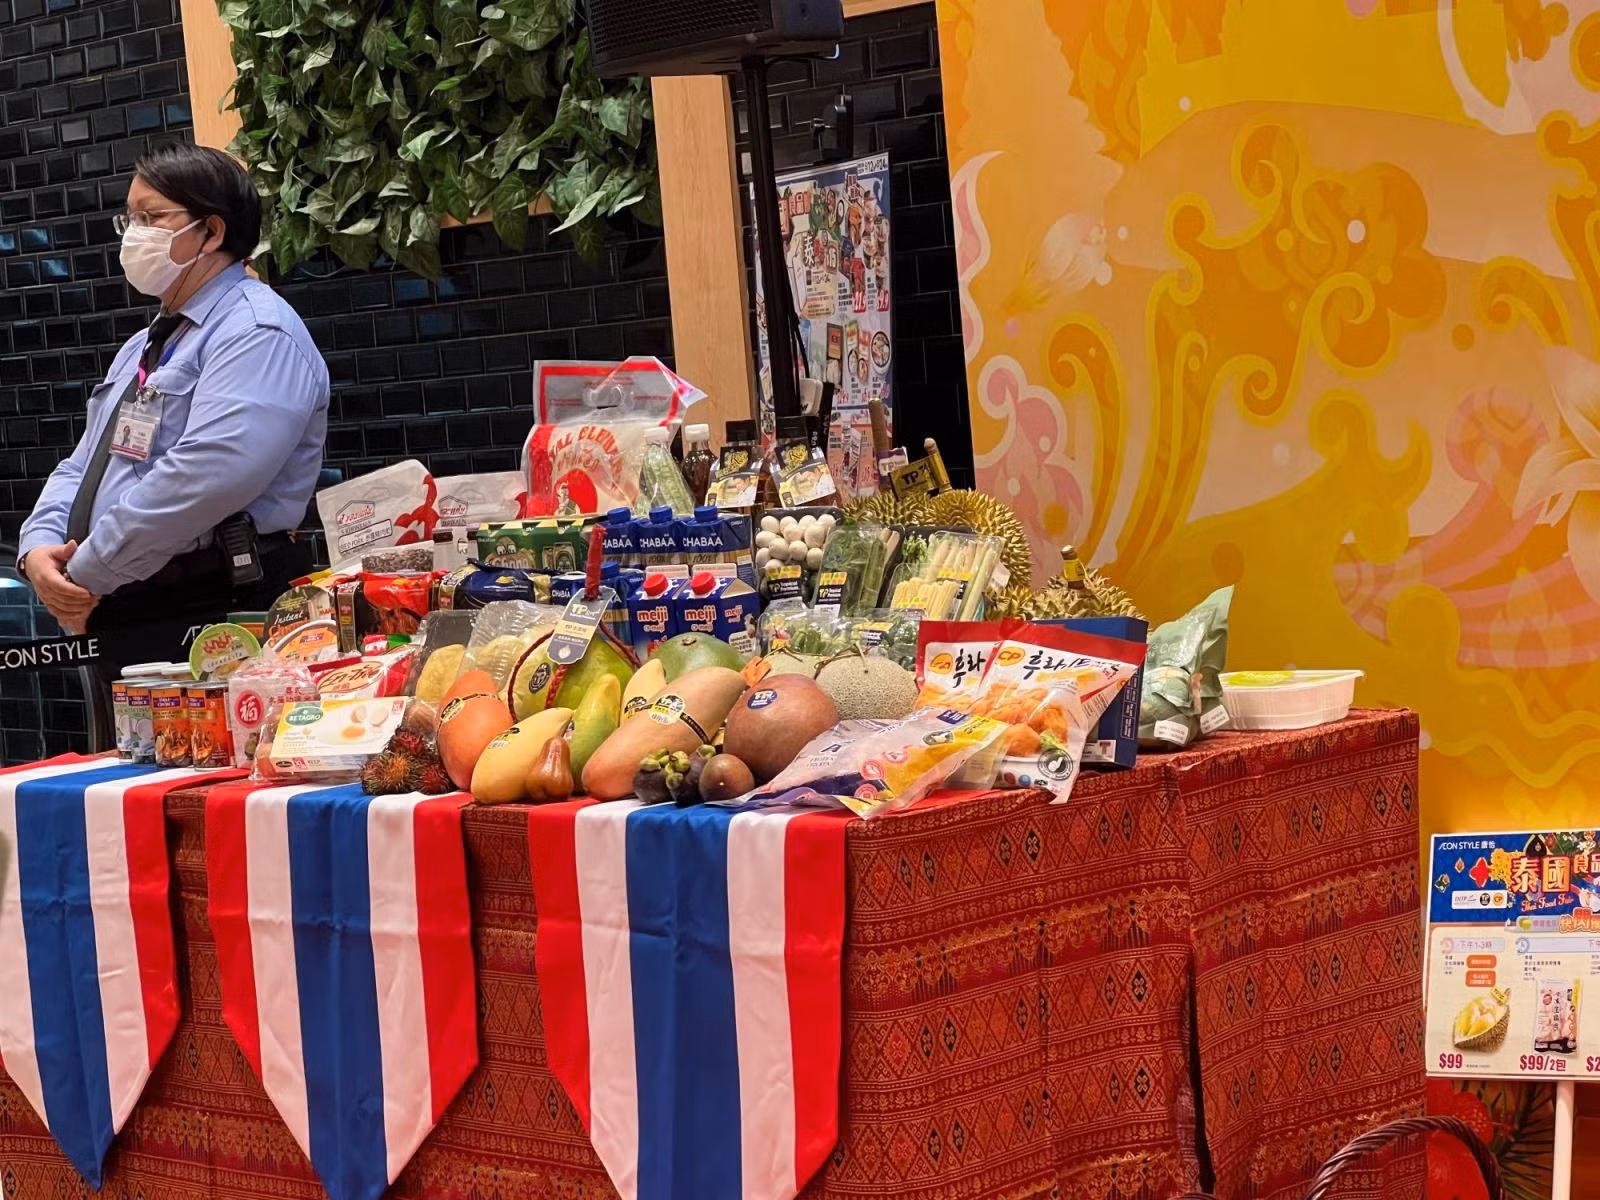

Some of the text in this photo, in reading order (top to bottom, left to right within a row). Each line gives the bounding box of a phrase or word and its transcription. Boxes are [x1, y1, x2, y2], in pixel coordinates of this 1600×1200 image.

[602, 538, 633, 549] HABAA
[274, 610, 304, 625] Instant
[637, 606, 669, 623] meiji
[685, 605, 716, 622] meiji
[41, 638, 100, 664] STYLE
[240, 695, 259, 722] 福
[288, 714, 321, 722] BETAGRO
[1458, 840, 1480, 850] STYLE
[1439, 1052, 1463, 1070] $99
